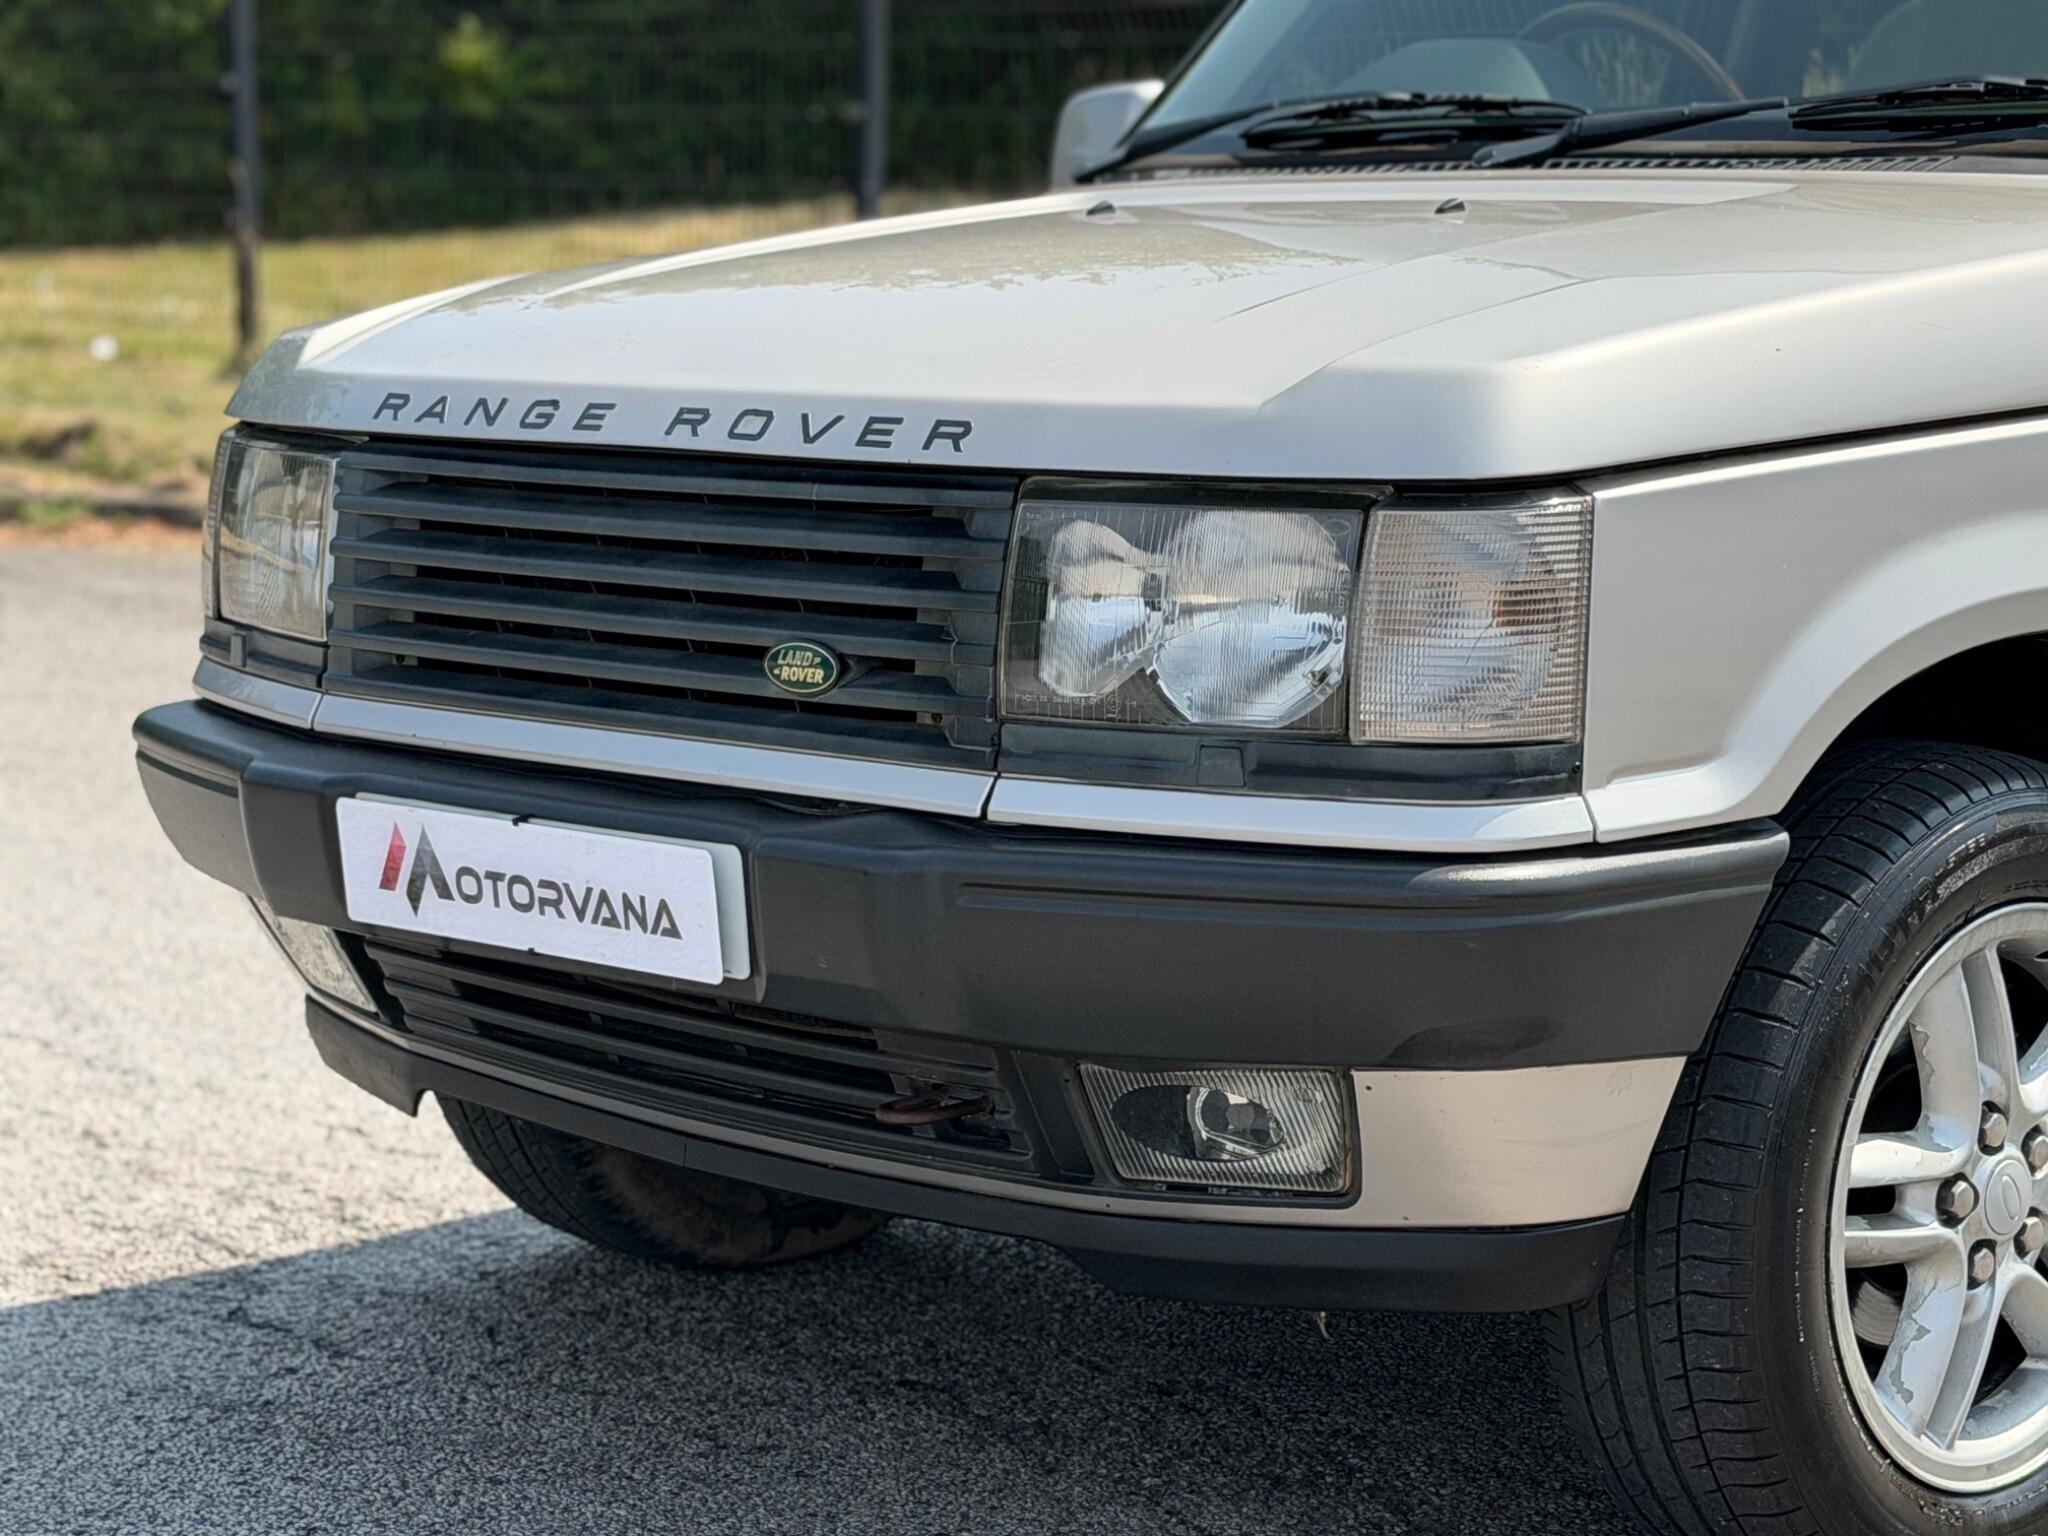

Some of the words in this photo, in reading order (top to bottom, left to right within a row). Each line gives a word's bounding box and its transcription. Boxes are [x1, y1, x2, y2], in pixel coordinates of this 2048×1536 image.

[373, 392, 617, 432] RANGE
[664, 407, 972, 453] ROVER
[777, 649, 813, 666] LAND
[780, 666, 824, 684] ROVER
[378, 821, 683, 940] MOTORVANA
